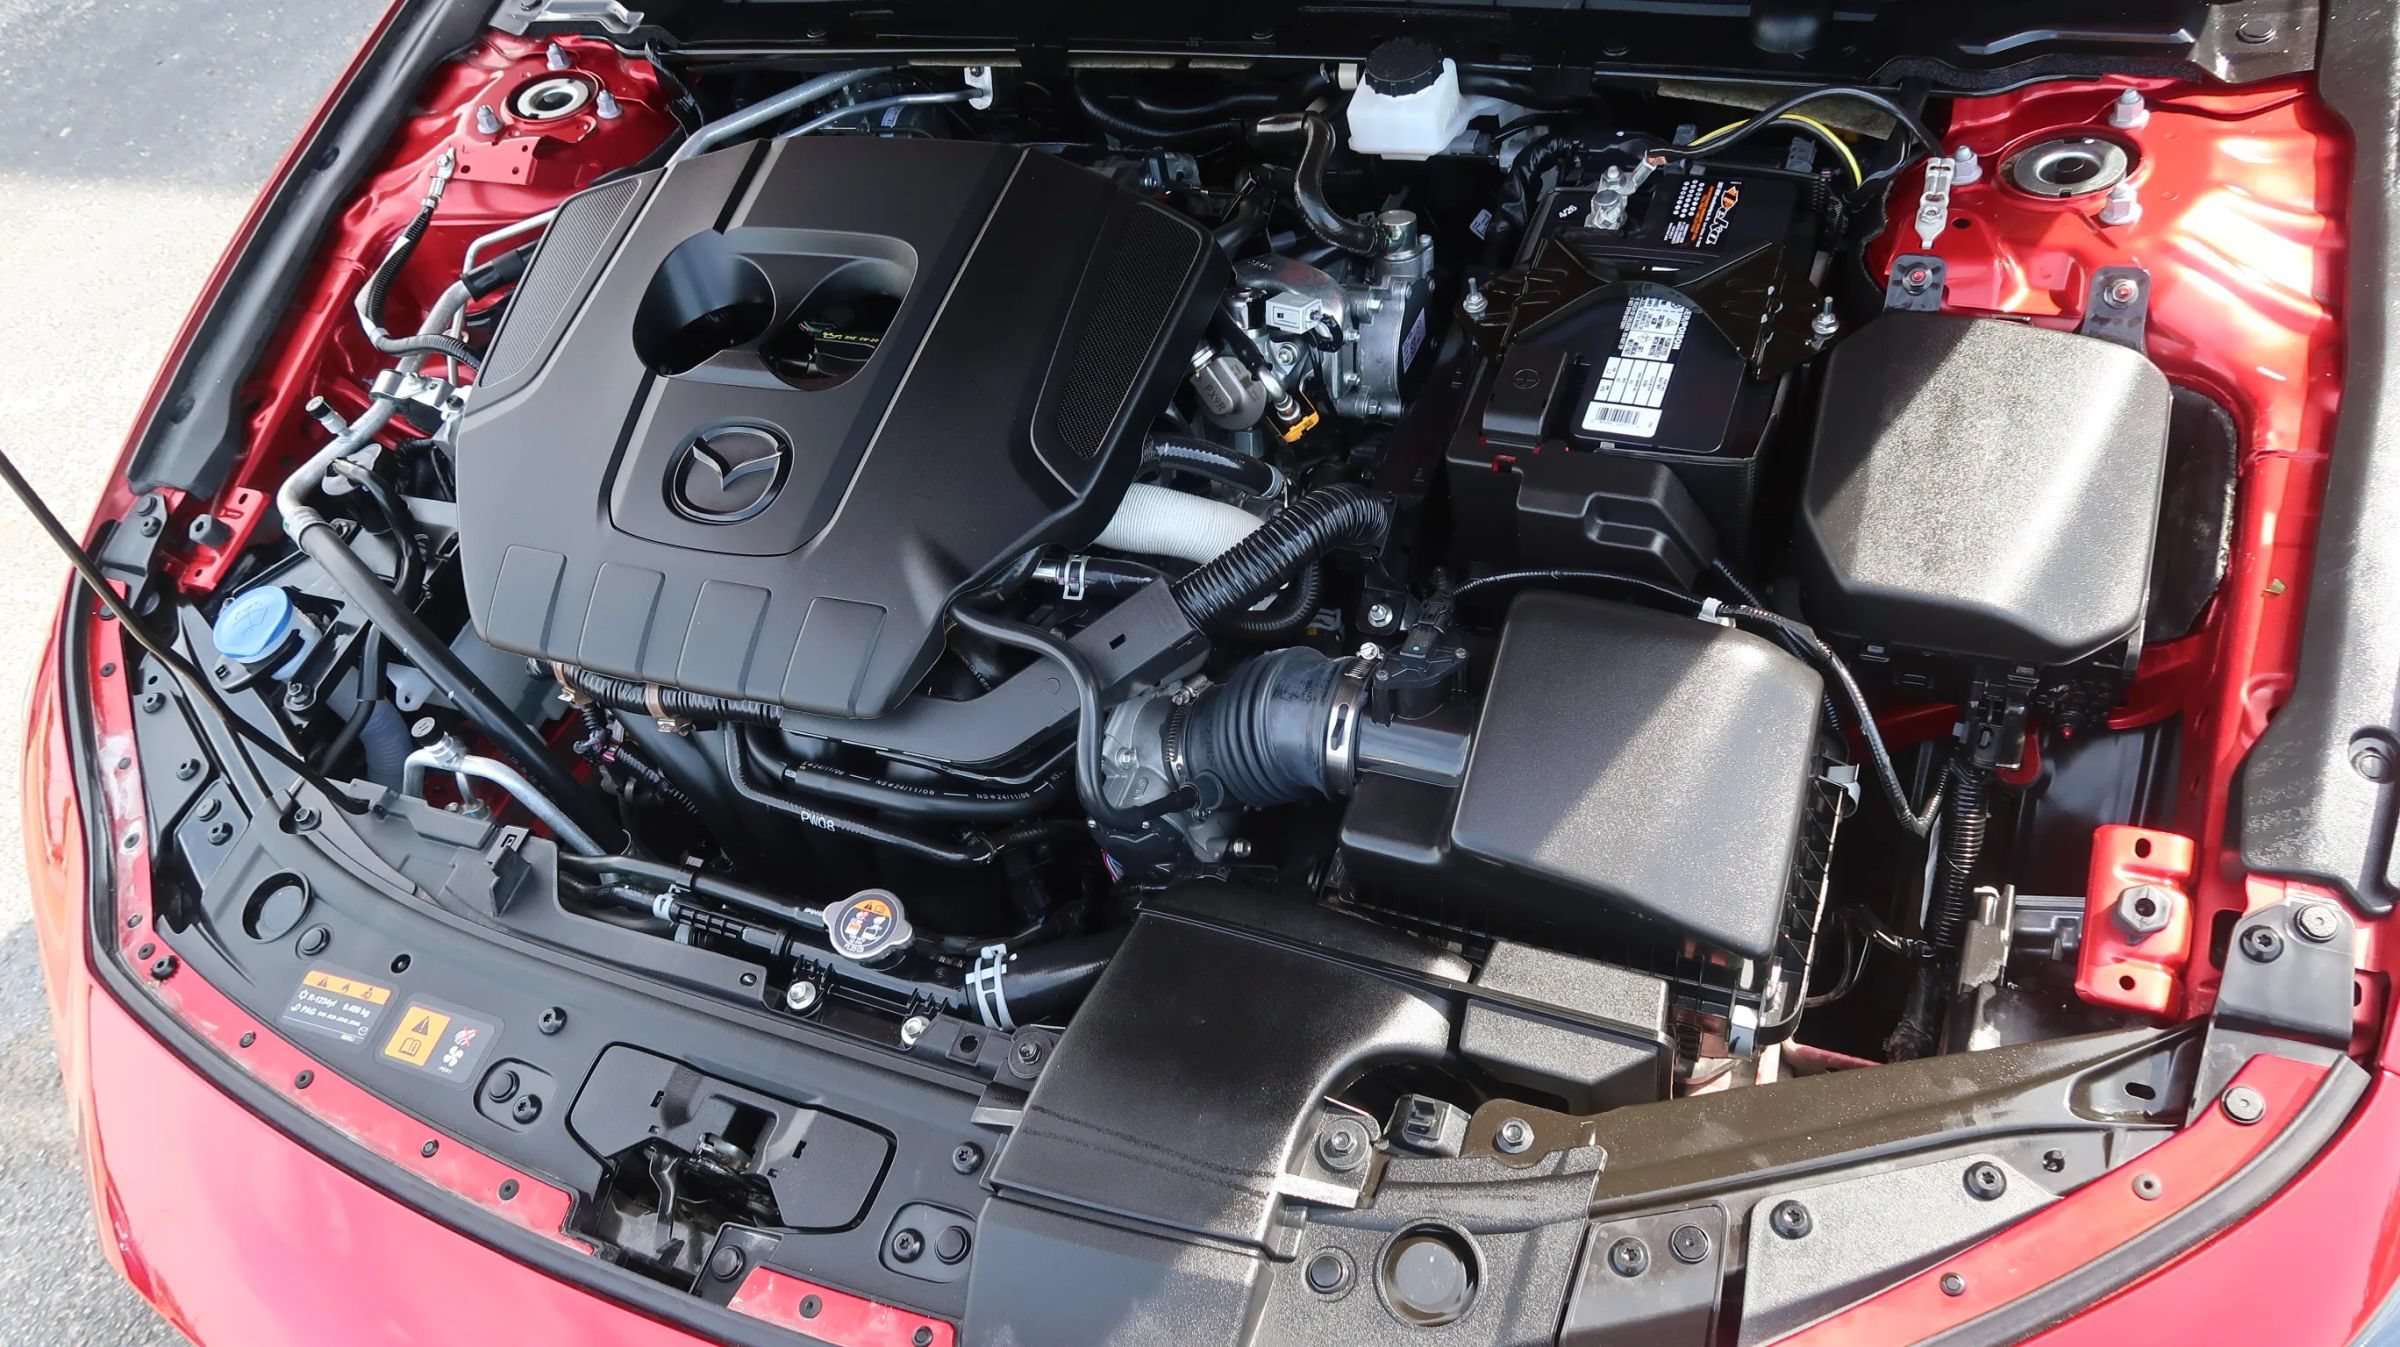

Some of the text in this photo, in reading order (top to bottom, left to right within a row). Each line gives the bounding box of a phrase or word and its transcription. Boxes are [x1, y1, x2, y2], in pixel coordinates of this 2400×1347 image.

[1705, 185, 1739, 245] Deka
[801, 811, 835, 832] PW08
[300, 1005, 318, 1016] PAG
